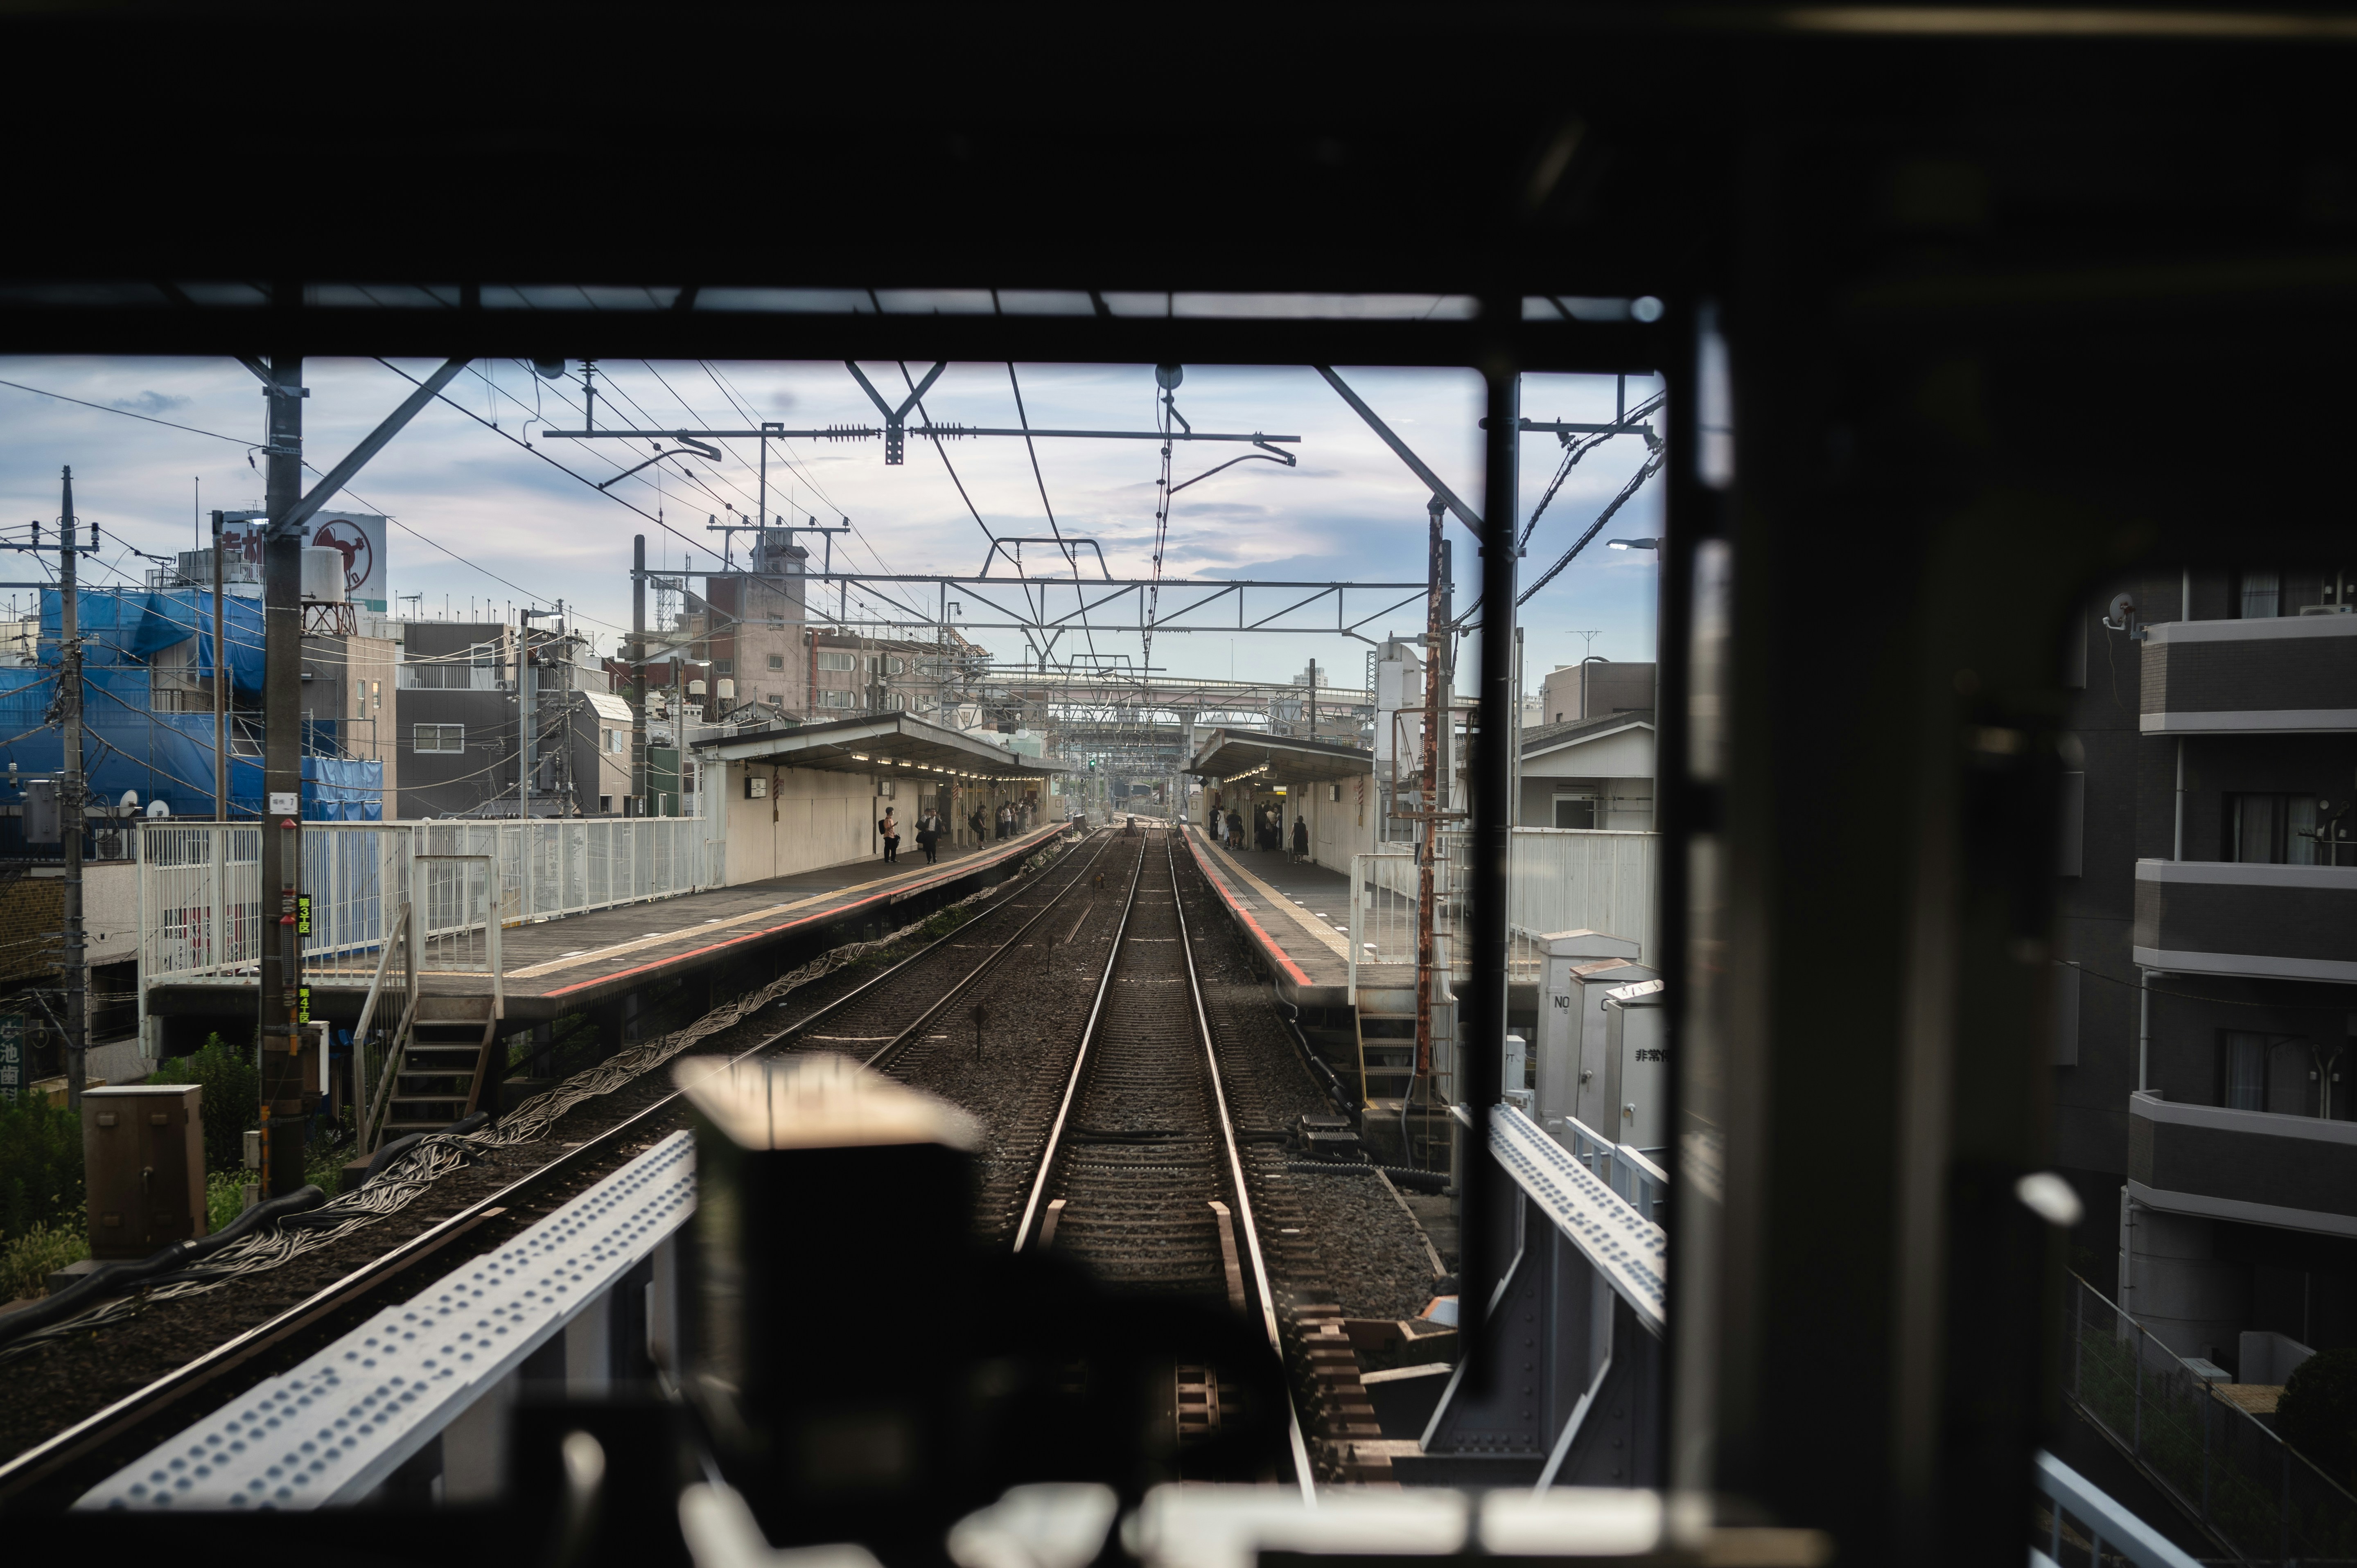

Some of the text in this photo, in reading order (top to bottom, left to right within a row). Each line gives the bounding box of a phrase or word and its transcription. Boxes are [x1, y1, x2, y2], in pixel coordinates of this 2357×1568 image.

[298, 898, 310, 933] 第3工区
[299, 988, 310, 1023] 第4工区
[1554, 995, 1570, 1008] NO
